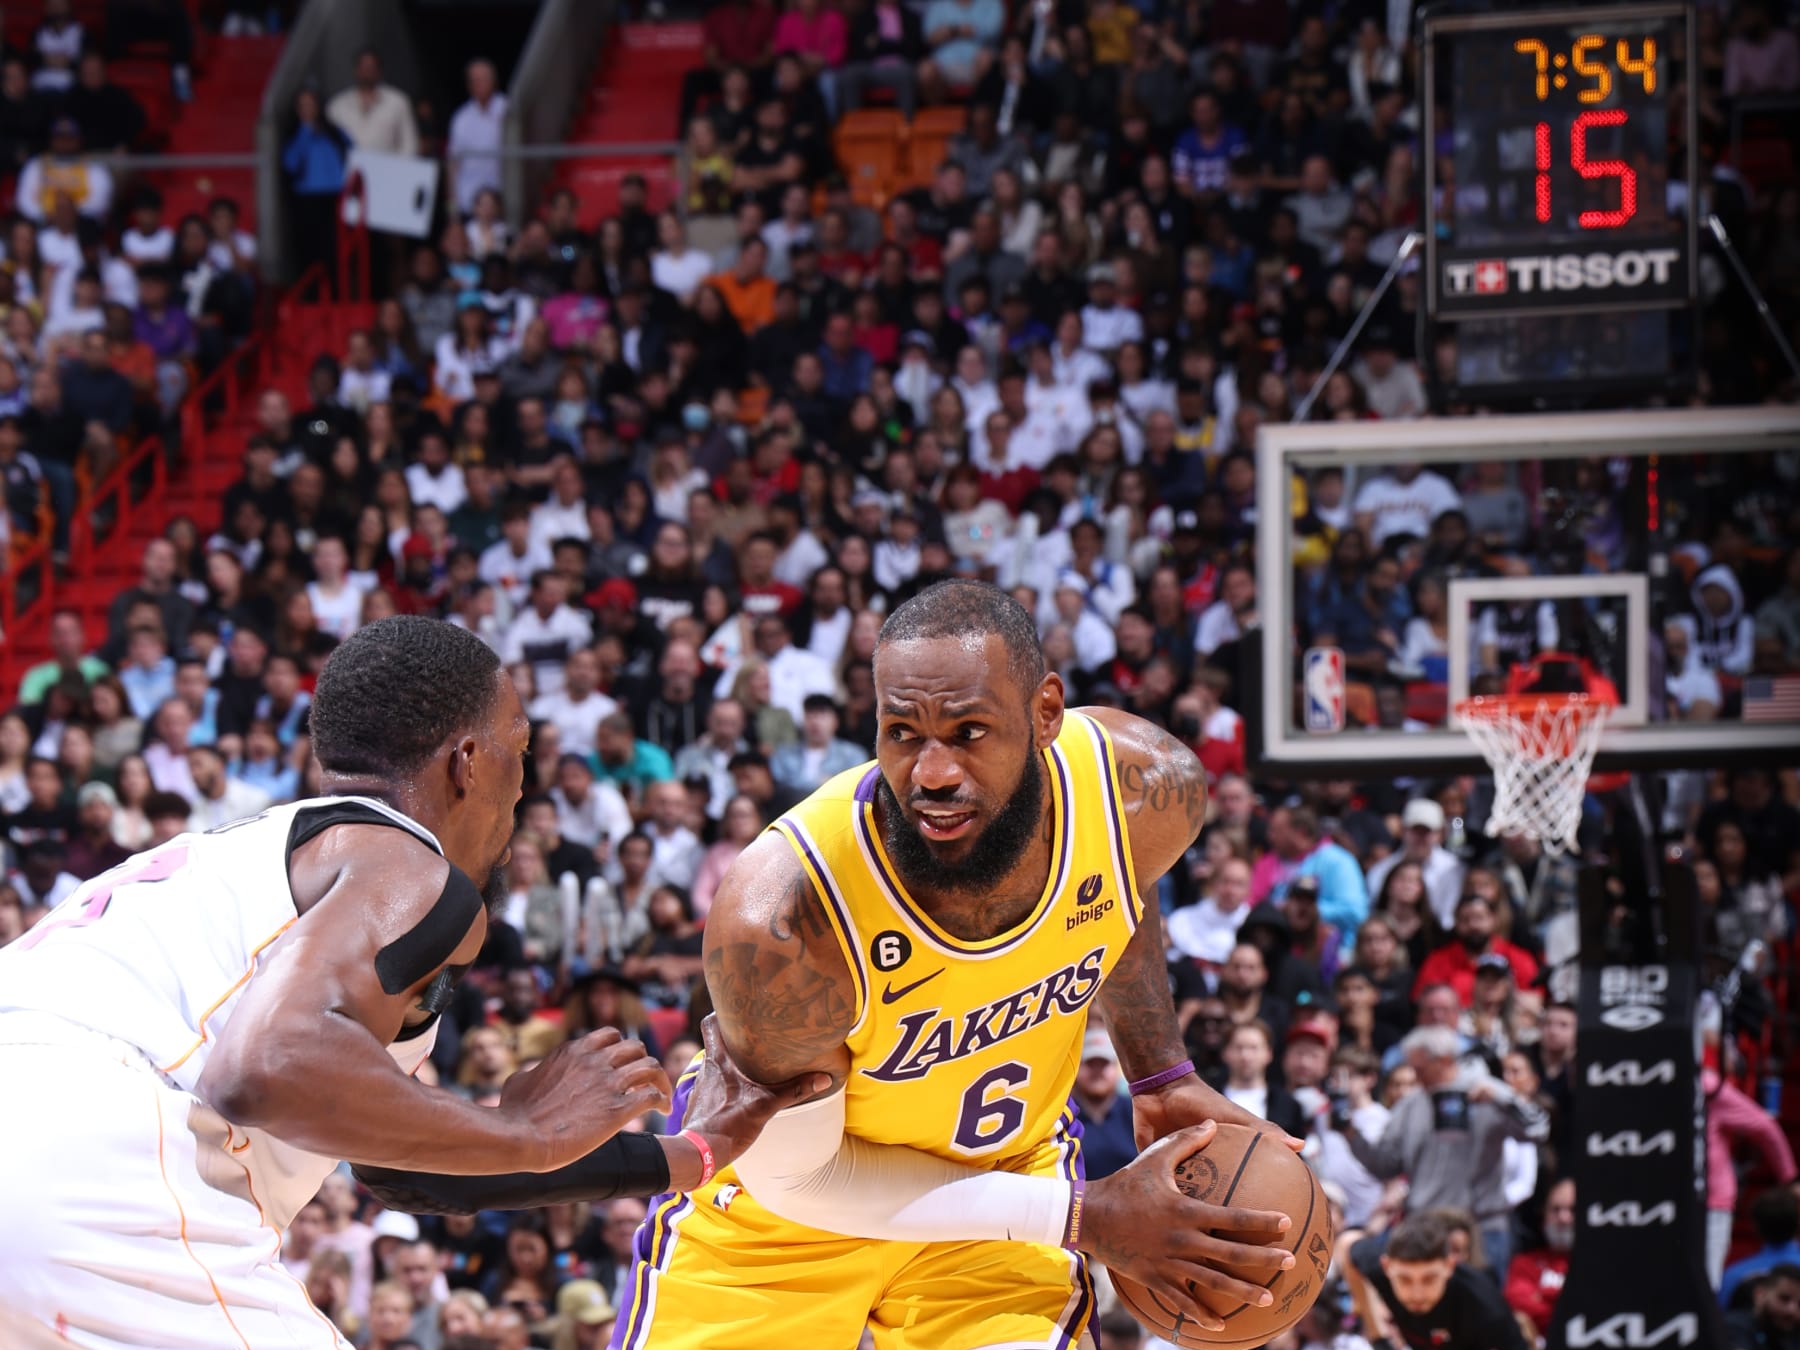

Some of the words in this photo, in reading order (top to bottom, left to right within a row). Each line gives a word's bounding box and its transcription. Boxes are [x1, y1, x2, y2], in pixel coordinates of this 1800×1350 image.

[1514, 34, 1656, 104] 7:54
[1535, 109, 1637, 229] 15
[1508, 249, 1680, 292] TISSOT
[1066, 898, 1114, 931] bibigo
[879, 936, 901, 968] 6
[858, 944, 1107, 1083] LAKERS
[951, 1059, 1032, 1156] 6
[1069, 1196, 1082, 1243] PROMISE
[1566, 1312, 1698, 1348] KIA
